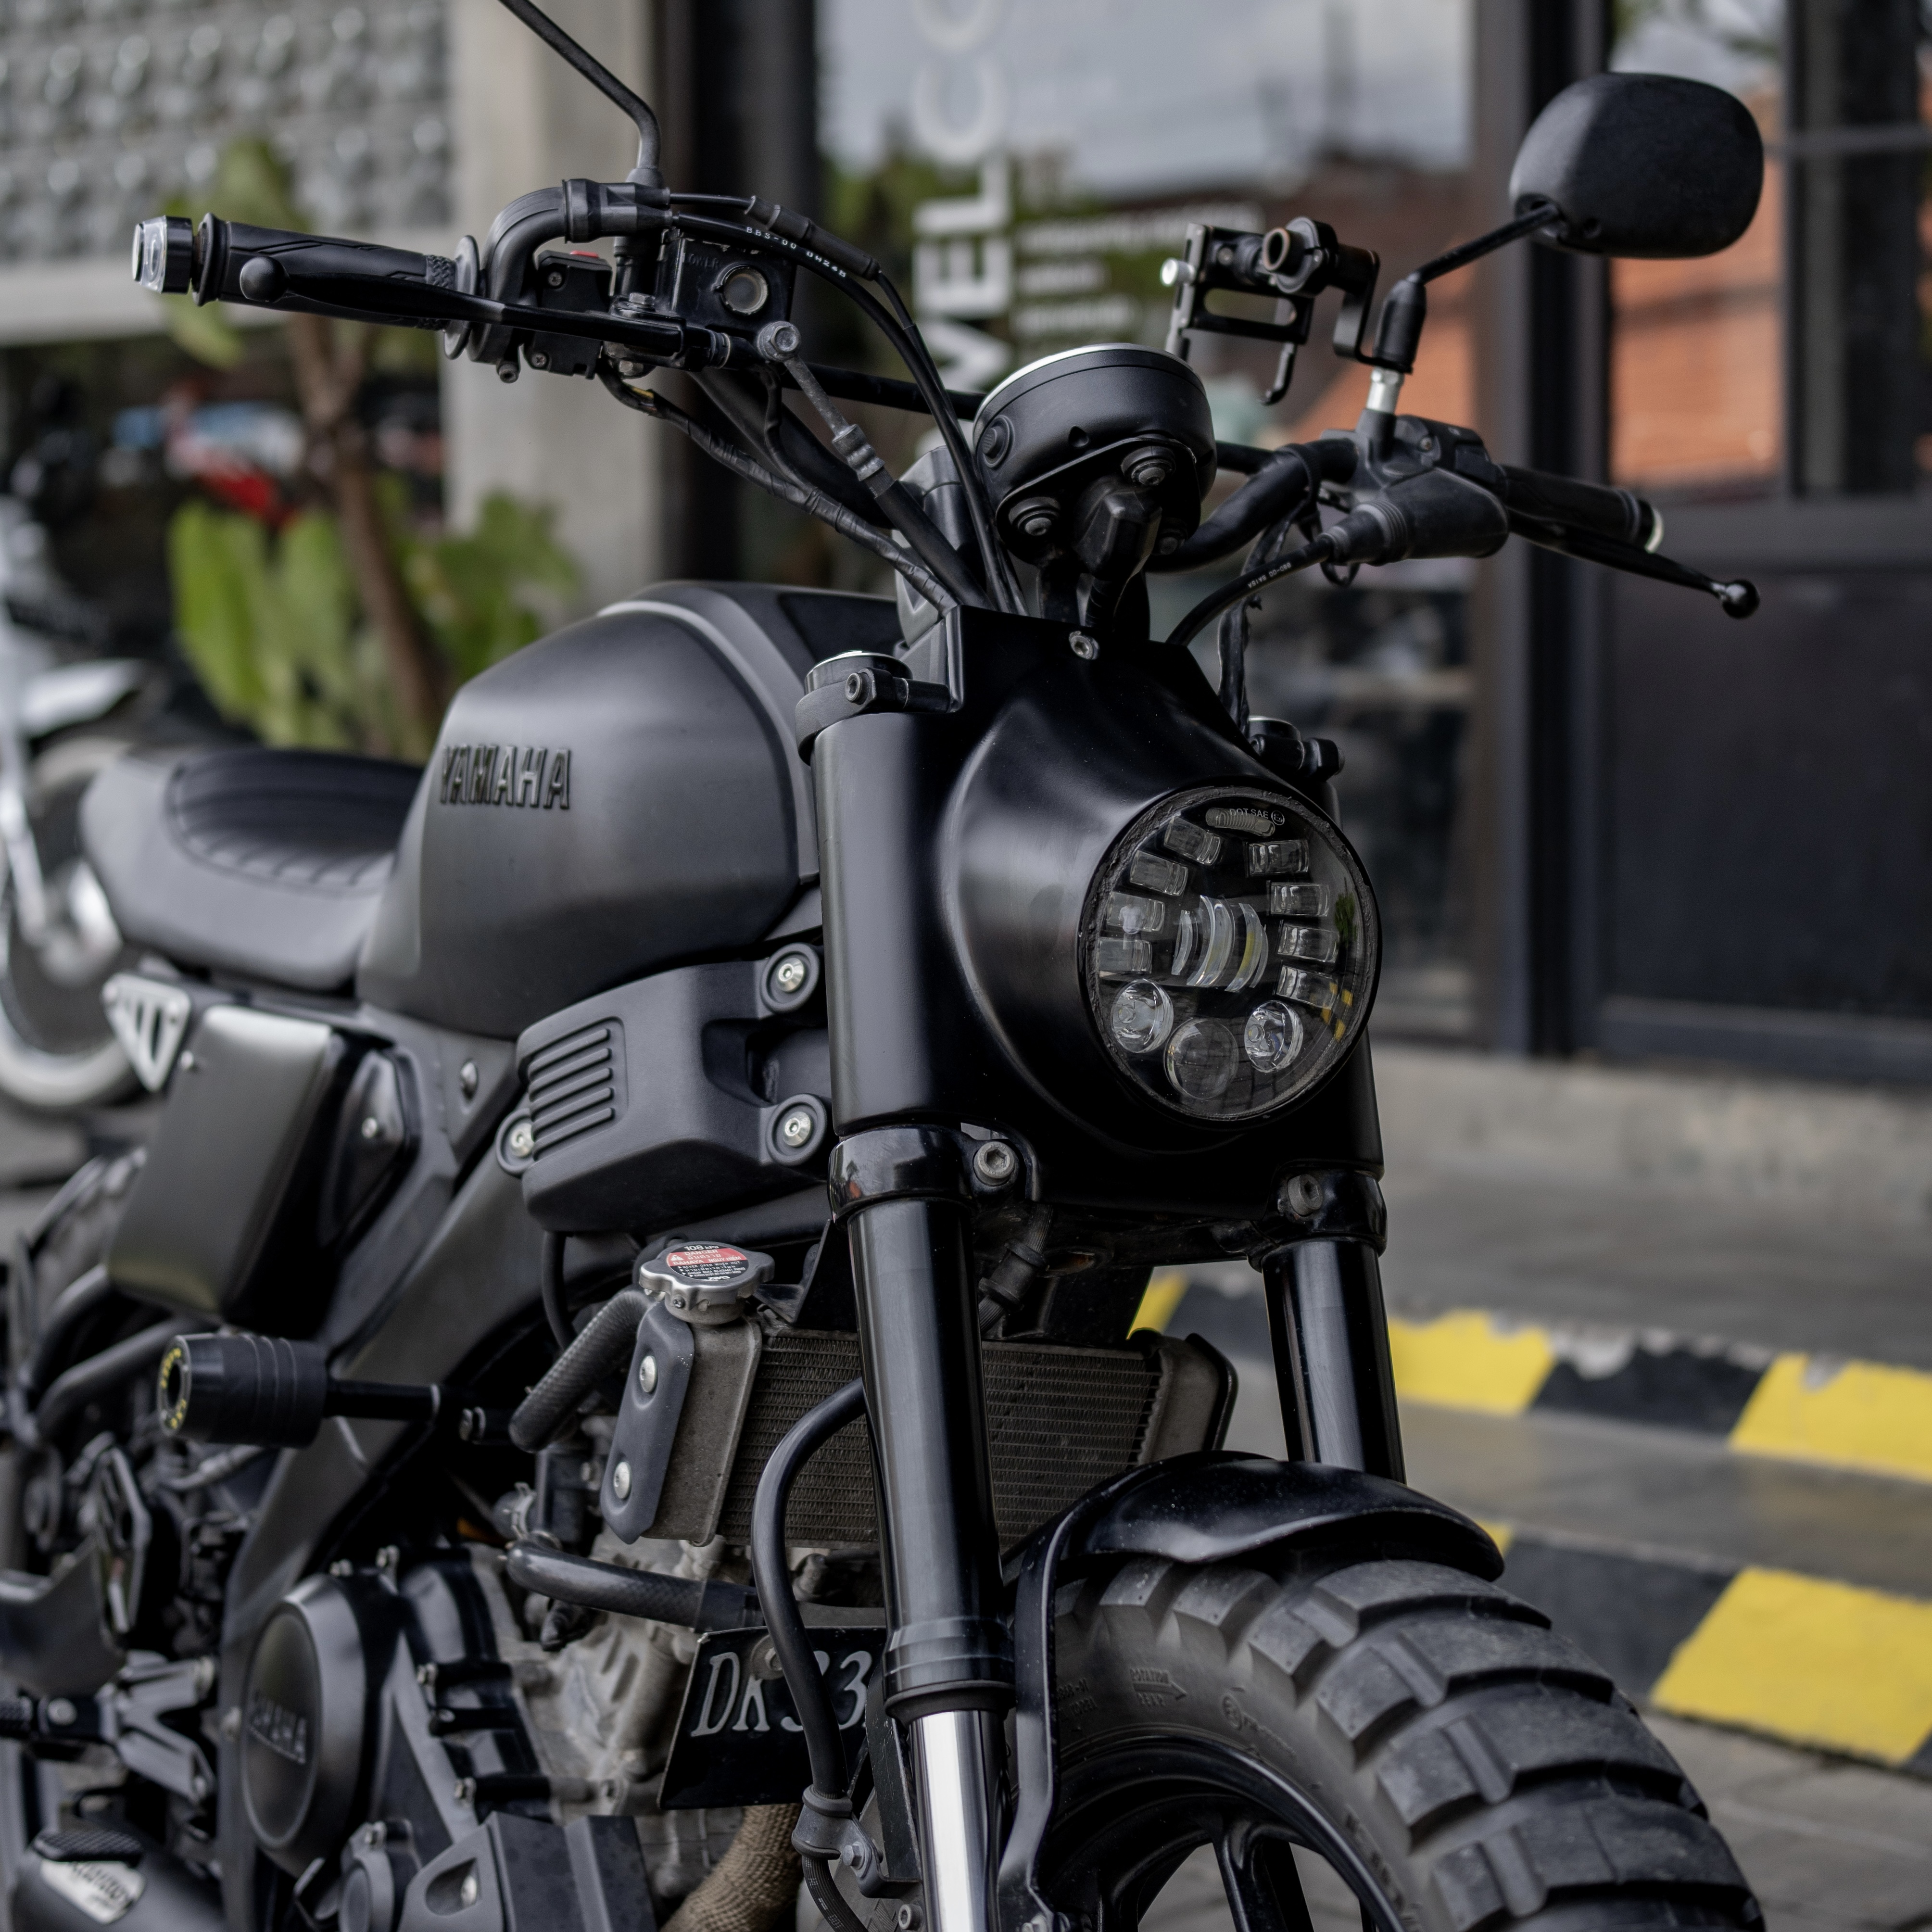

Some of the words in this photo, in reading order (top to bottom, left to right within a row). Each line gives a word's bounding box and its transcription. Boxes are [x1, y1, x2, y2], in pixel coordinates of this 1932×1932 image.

[440, 744, 571, 810] YAMAHA
[1229, 808, 1249, 817] DOT
[1250, 809, 1269, 819] SAE
